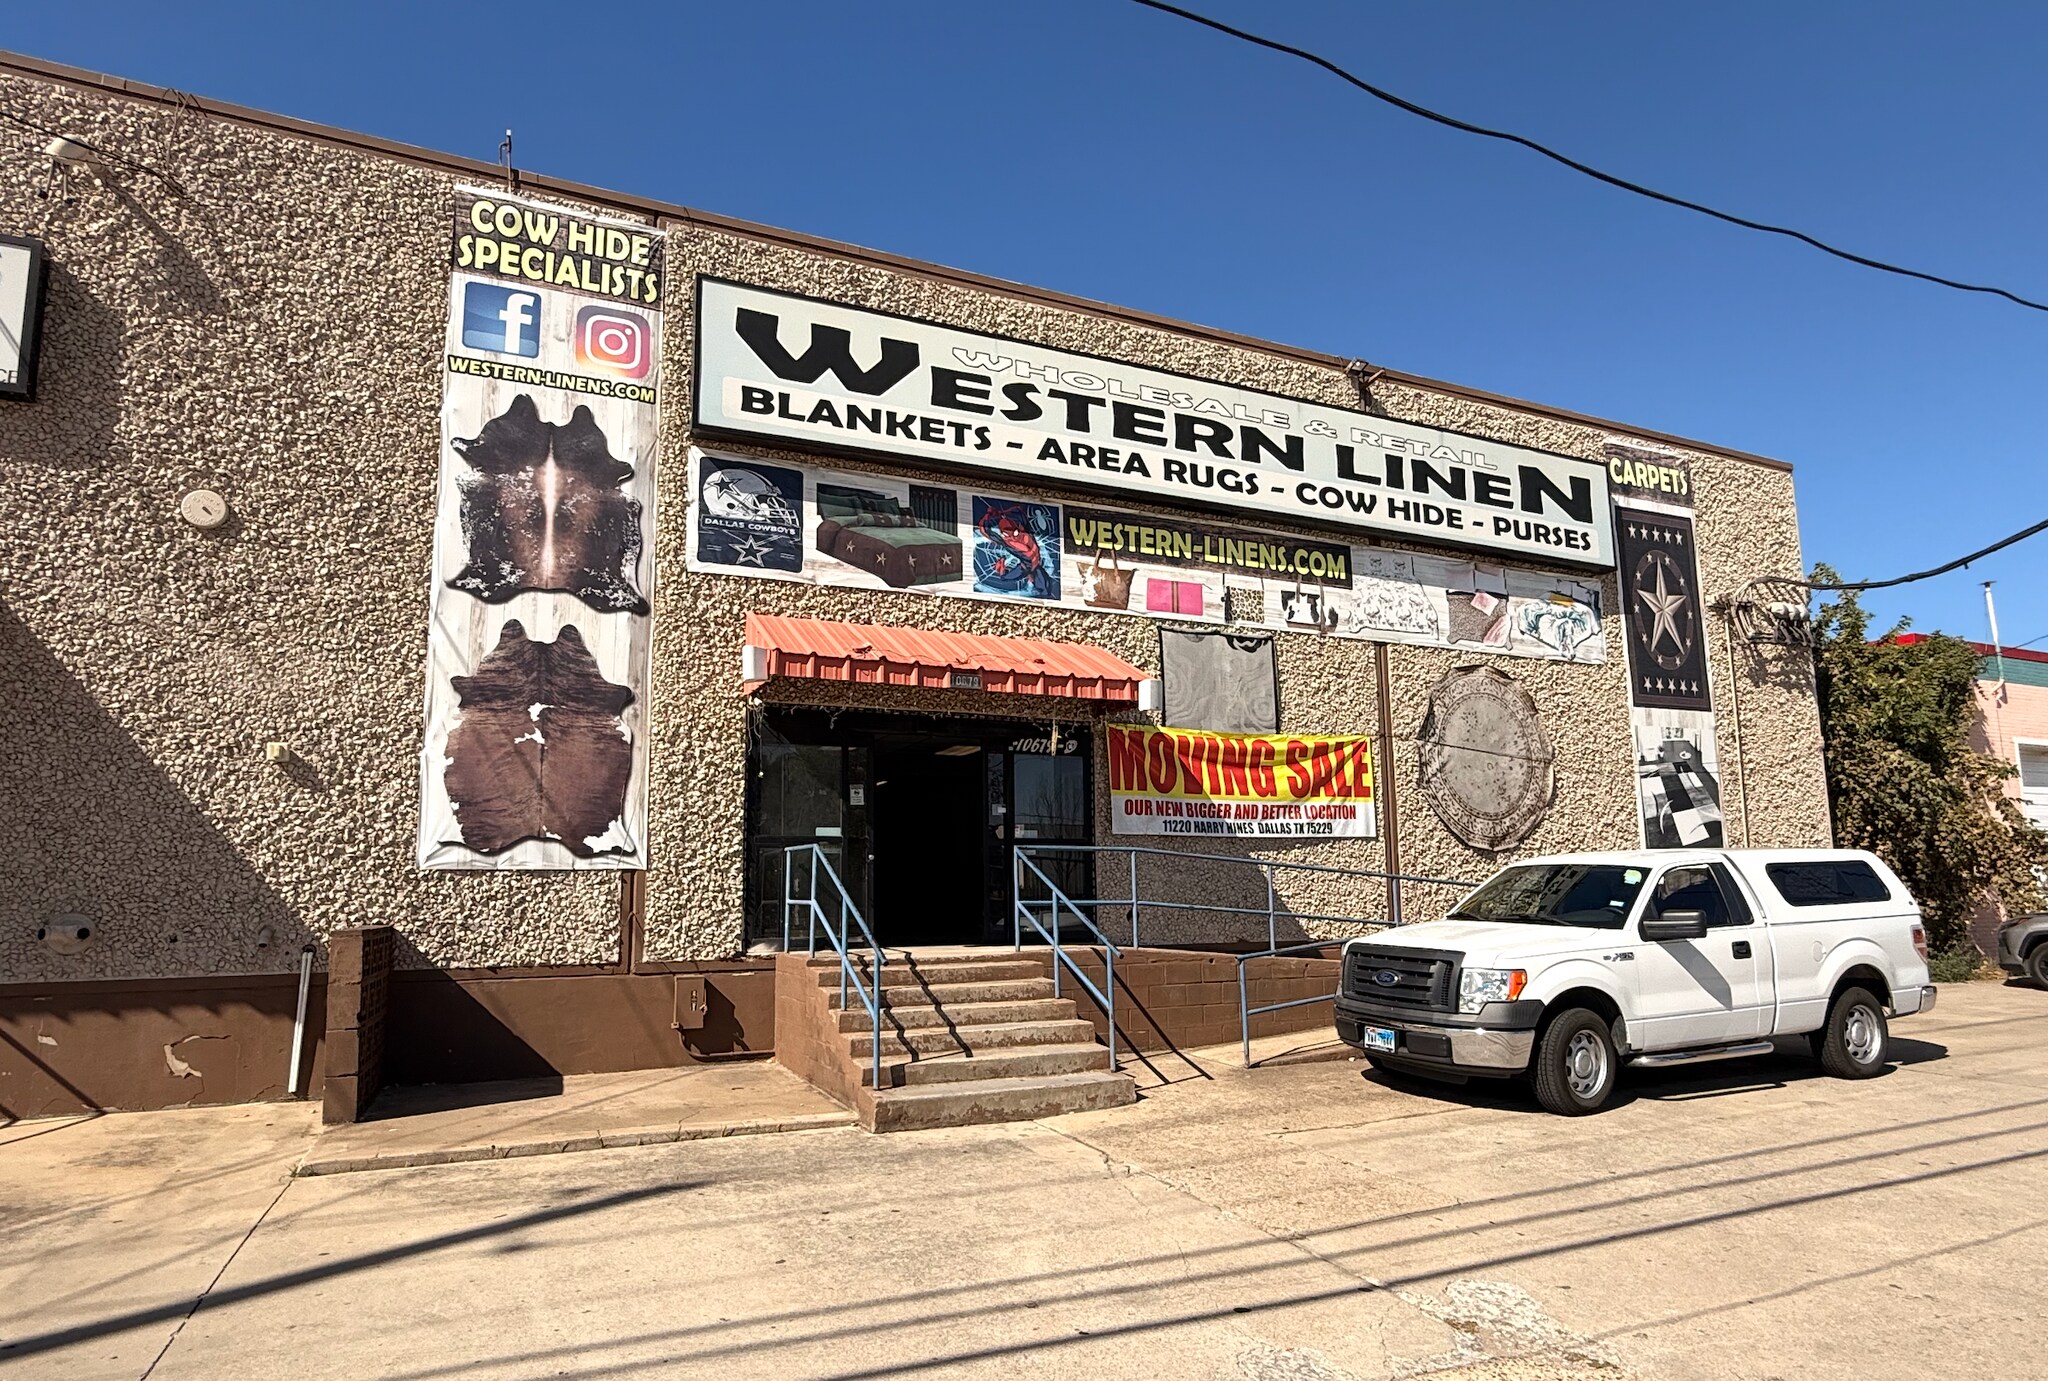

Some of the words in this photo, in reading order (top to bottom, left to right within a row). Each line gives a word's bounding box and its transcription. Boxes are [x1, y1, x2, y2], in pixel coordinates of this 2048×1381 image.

[471, 201, 559, 246] COW
[568, 221, 650, 267] HIDE
[457, 234, 658, 303] SPECIALISTS
[448, 356, 656, 403] WESTERN-LINENS.COM
[952, 347, 1290, 429] WHOLESALE
[1304, 419, 1338, 439] &
[1351, 428, 1498, 470] RETAIL
[736, 307, 1304, 472] WESTERN
[1336, 443, 1593, 523] LINEN
[741, 386, 991, 450] BLANKETS
[1036, 438, 1151, 478] AREA
[1164, 458, 1259, 495] RUGS
[1296, 483, 1378, 515] COW
[1388, 499, 1462, 529] HIDE
[1493, 516, 1591, 552] PURSES
[1609, 457, 1688, 496] CARPETS
[704, 518, 744, 528] DALLAS
[748, 524, 796, 535] COWBOYS
[1069, 517, 1346, 580] WESTERN-LINENS.COM
[1108, 727, 1277, 797] MOVING
[1285, 737, 1371, 798] SALE
[1124, 799, 1152, 816] OUR
[1156, 800, 1183, 817] NEW
[1186, 802, 1231, 819] BIGGER
[1234, 803, 1258, 820] AND
[1261, 803, 1302, 820] BETTER
[1305, 804, 1356, 820] LOCATION
[1163, 820, 1191, 833] 11220
[1194, 821, 1225, 834] HARRY
[1227, 821, 1254, 834] HINES
[1259, 822, 1292, 834] DALLAS
[1294, 822, 1305, 834] TX
[1306, 822, 1333, 834] 75229
